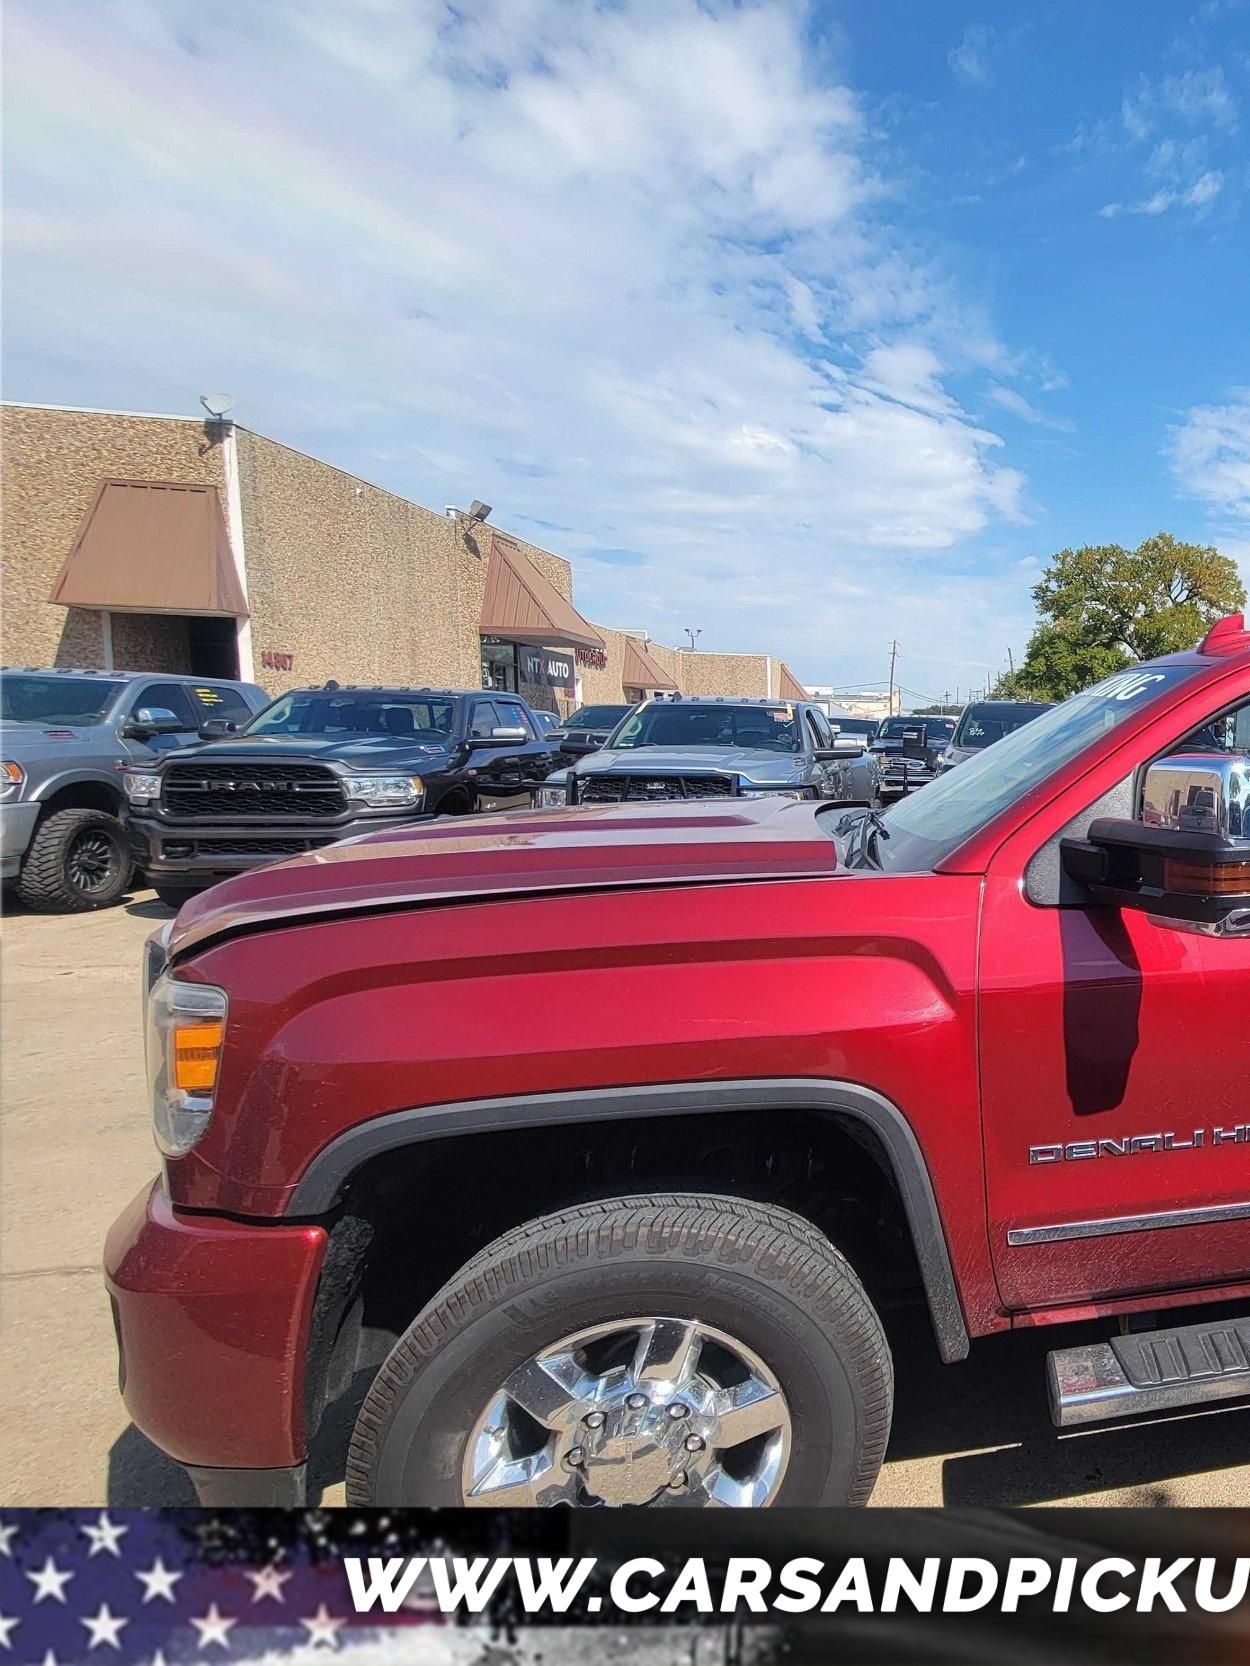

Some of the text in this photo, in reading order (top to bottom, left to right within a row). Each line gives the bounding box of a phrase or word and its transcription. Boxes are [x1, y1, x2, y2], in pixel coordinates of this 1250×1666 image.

[527, 657, 569, 678] NTX AUTO
[210, 779, 289, 791] RAM
[1029, 1128, 1205, 1164] DENALI
